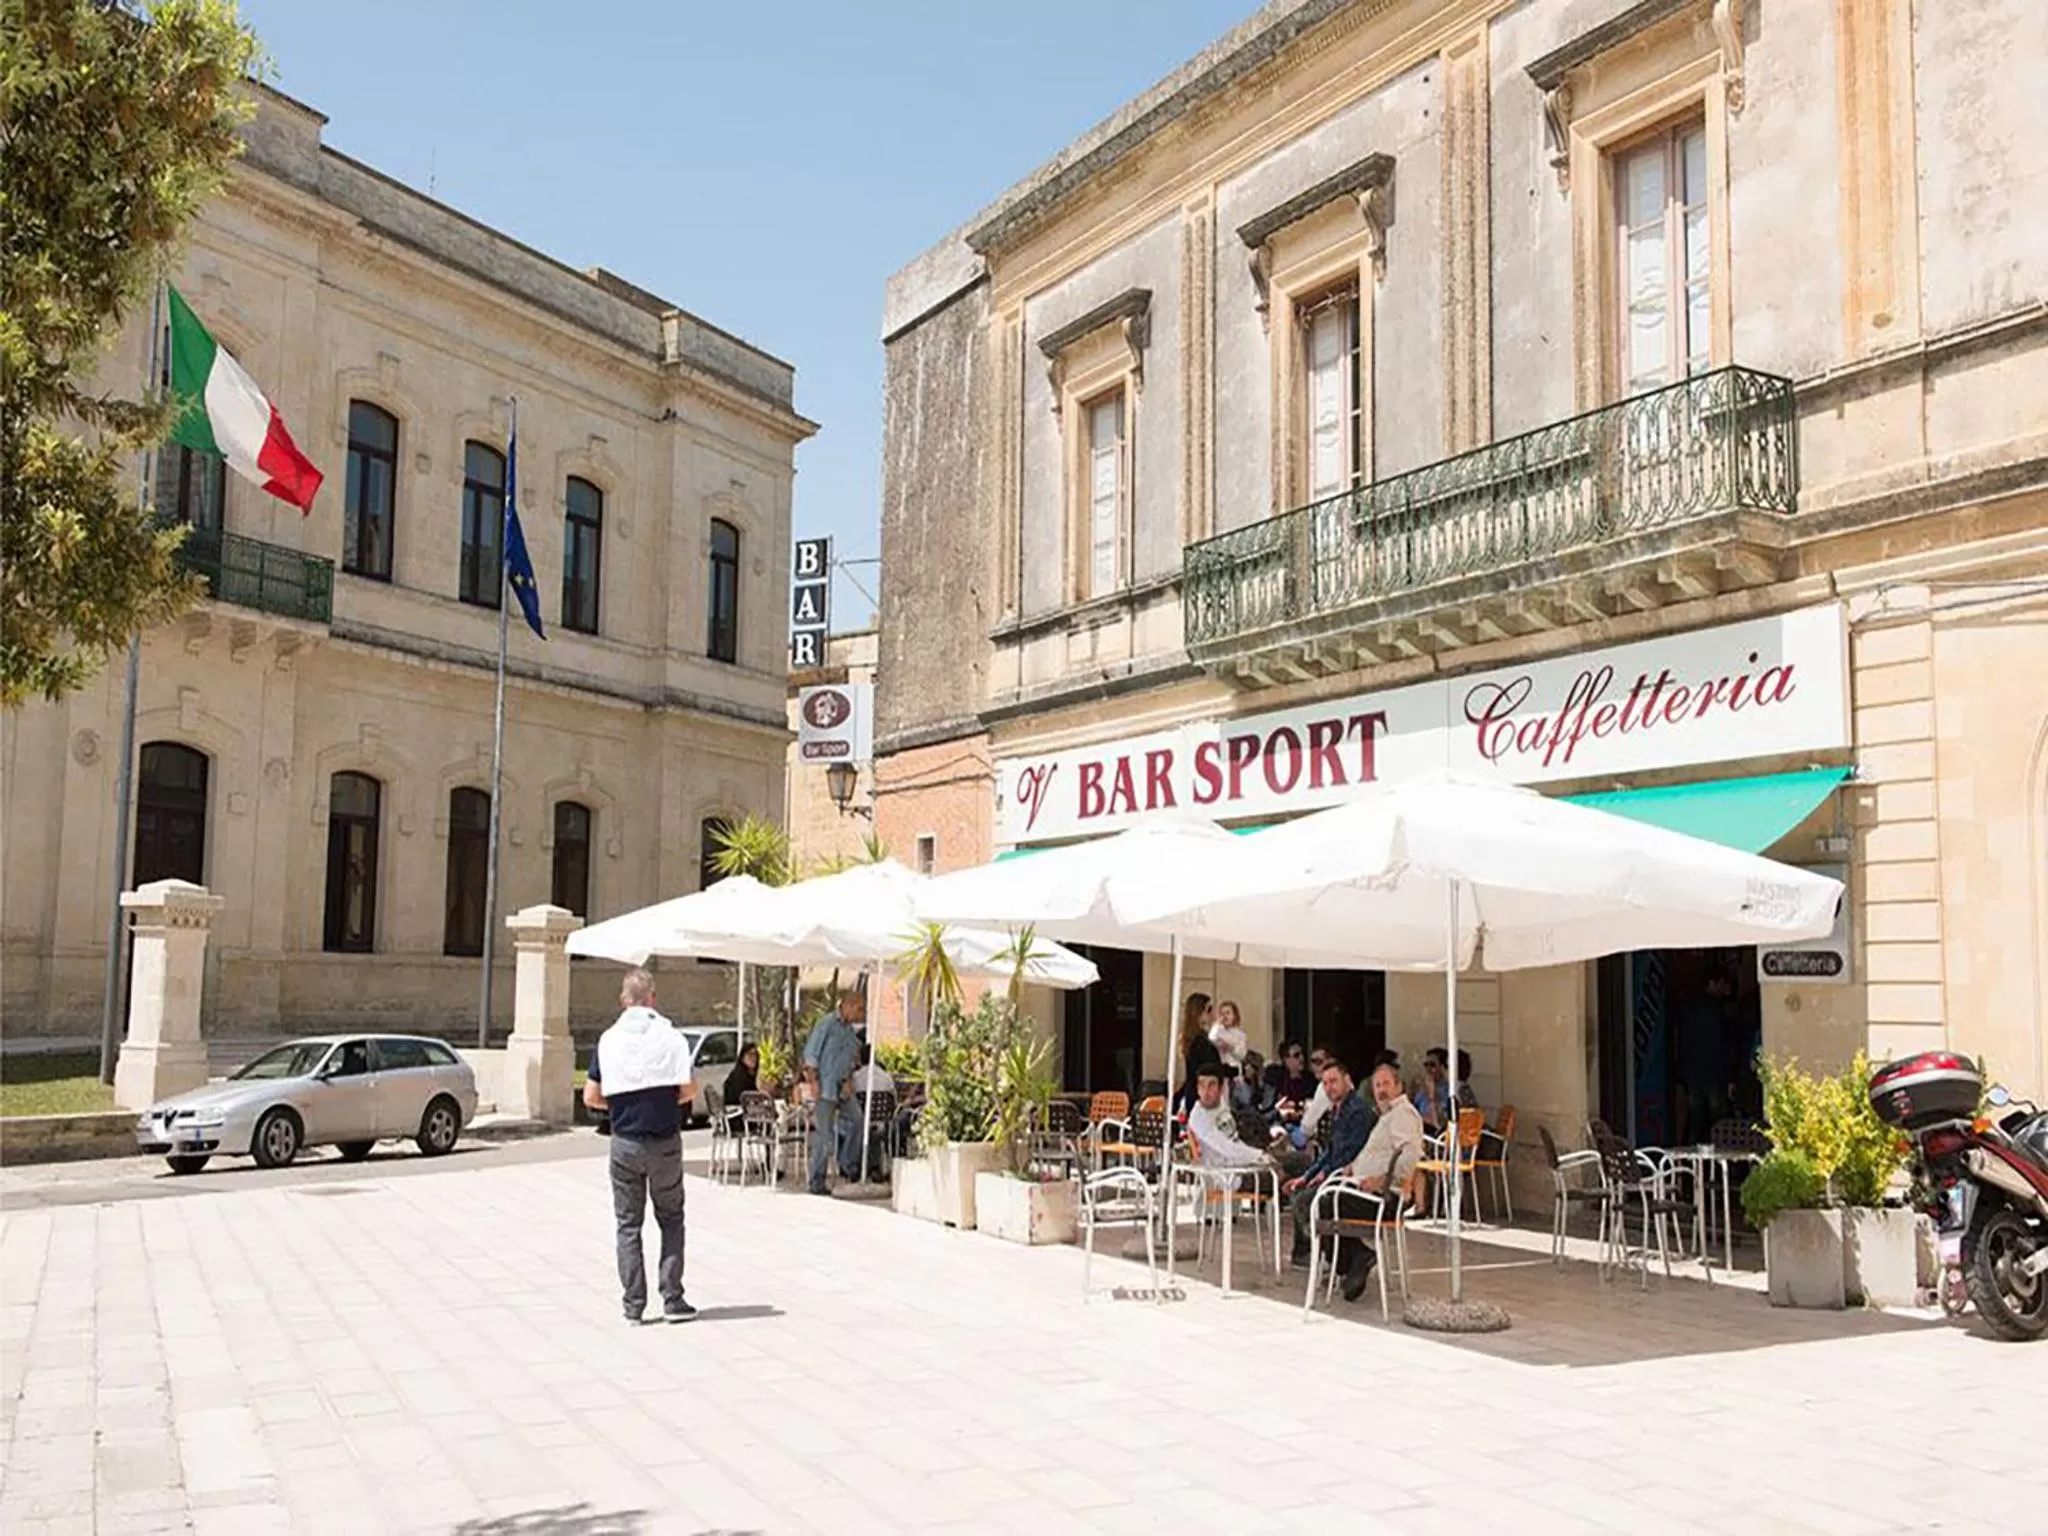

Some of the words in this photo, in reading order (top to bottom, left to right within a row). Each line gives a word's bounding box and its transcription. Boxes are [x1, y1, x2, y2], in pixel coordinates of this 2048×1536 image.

[794, 543, 818, 665] BAR
[1077, 748, 1178, 819] BAR
[1192, 710, 1389, 804] SPORT
[1464, 652, 1796, 768] Caffetteria
